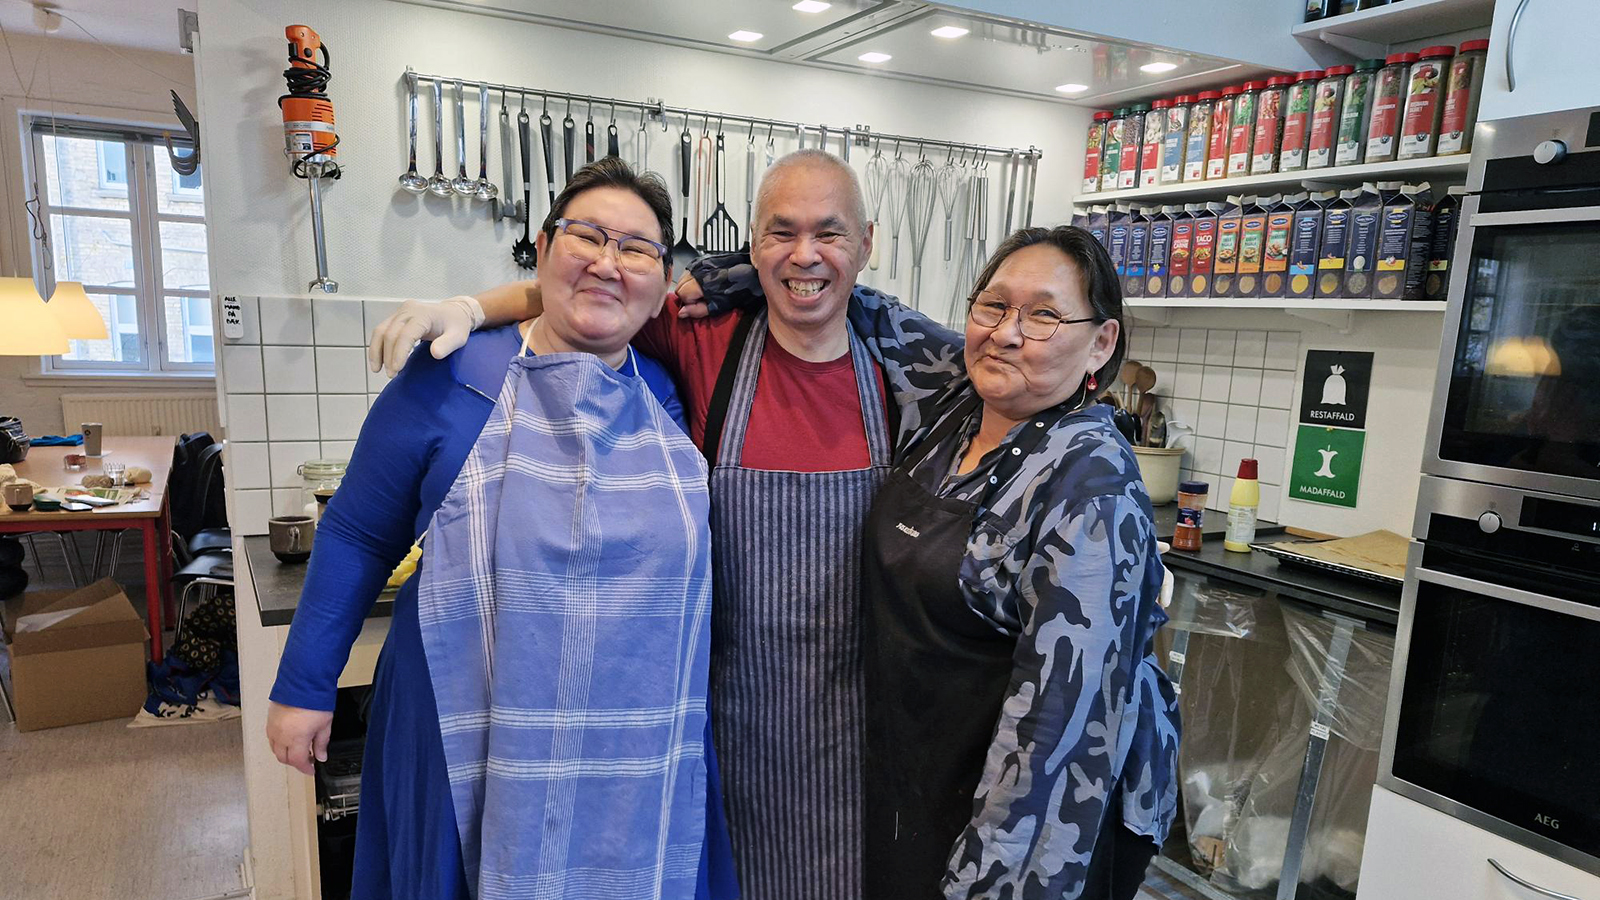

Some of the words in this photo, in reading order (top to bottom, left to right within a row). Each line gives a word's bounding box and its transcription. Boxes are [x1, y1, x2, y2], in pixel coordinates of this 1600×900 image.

[1196, 235, 1212, 243] TACO
[1310, 410, 1355, 421] RESTAFFALD
[1299, 485, 1346, 499] MADAFFALD
[1534, 813, 1560, 829] AEG
